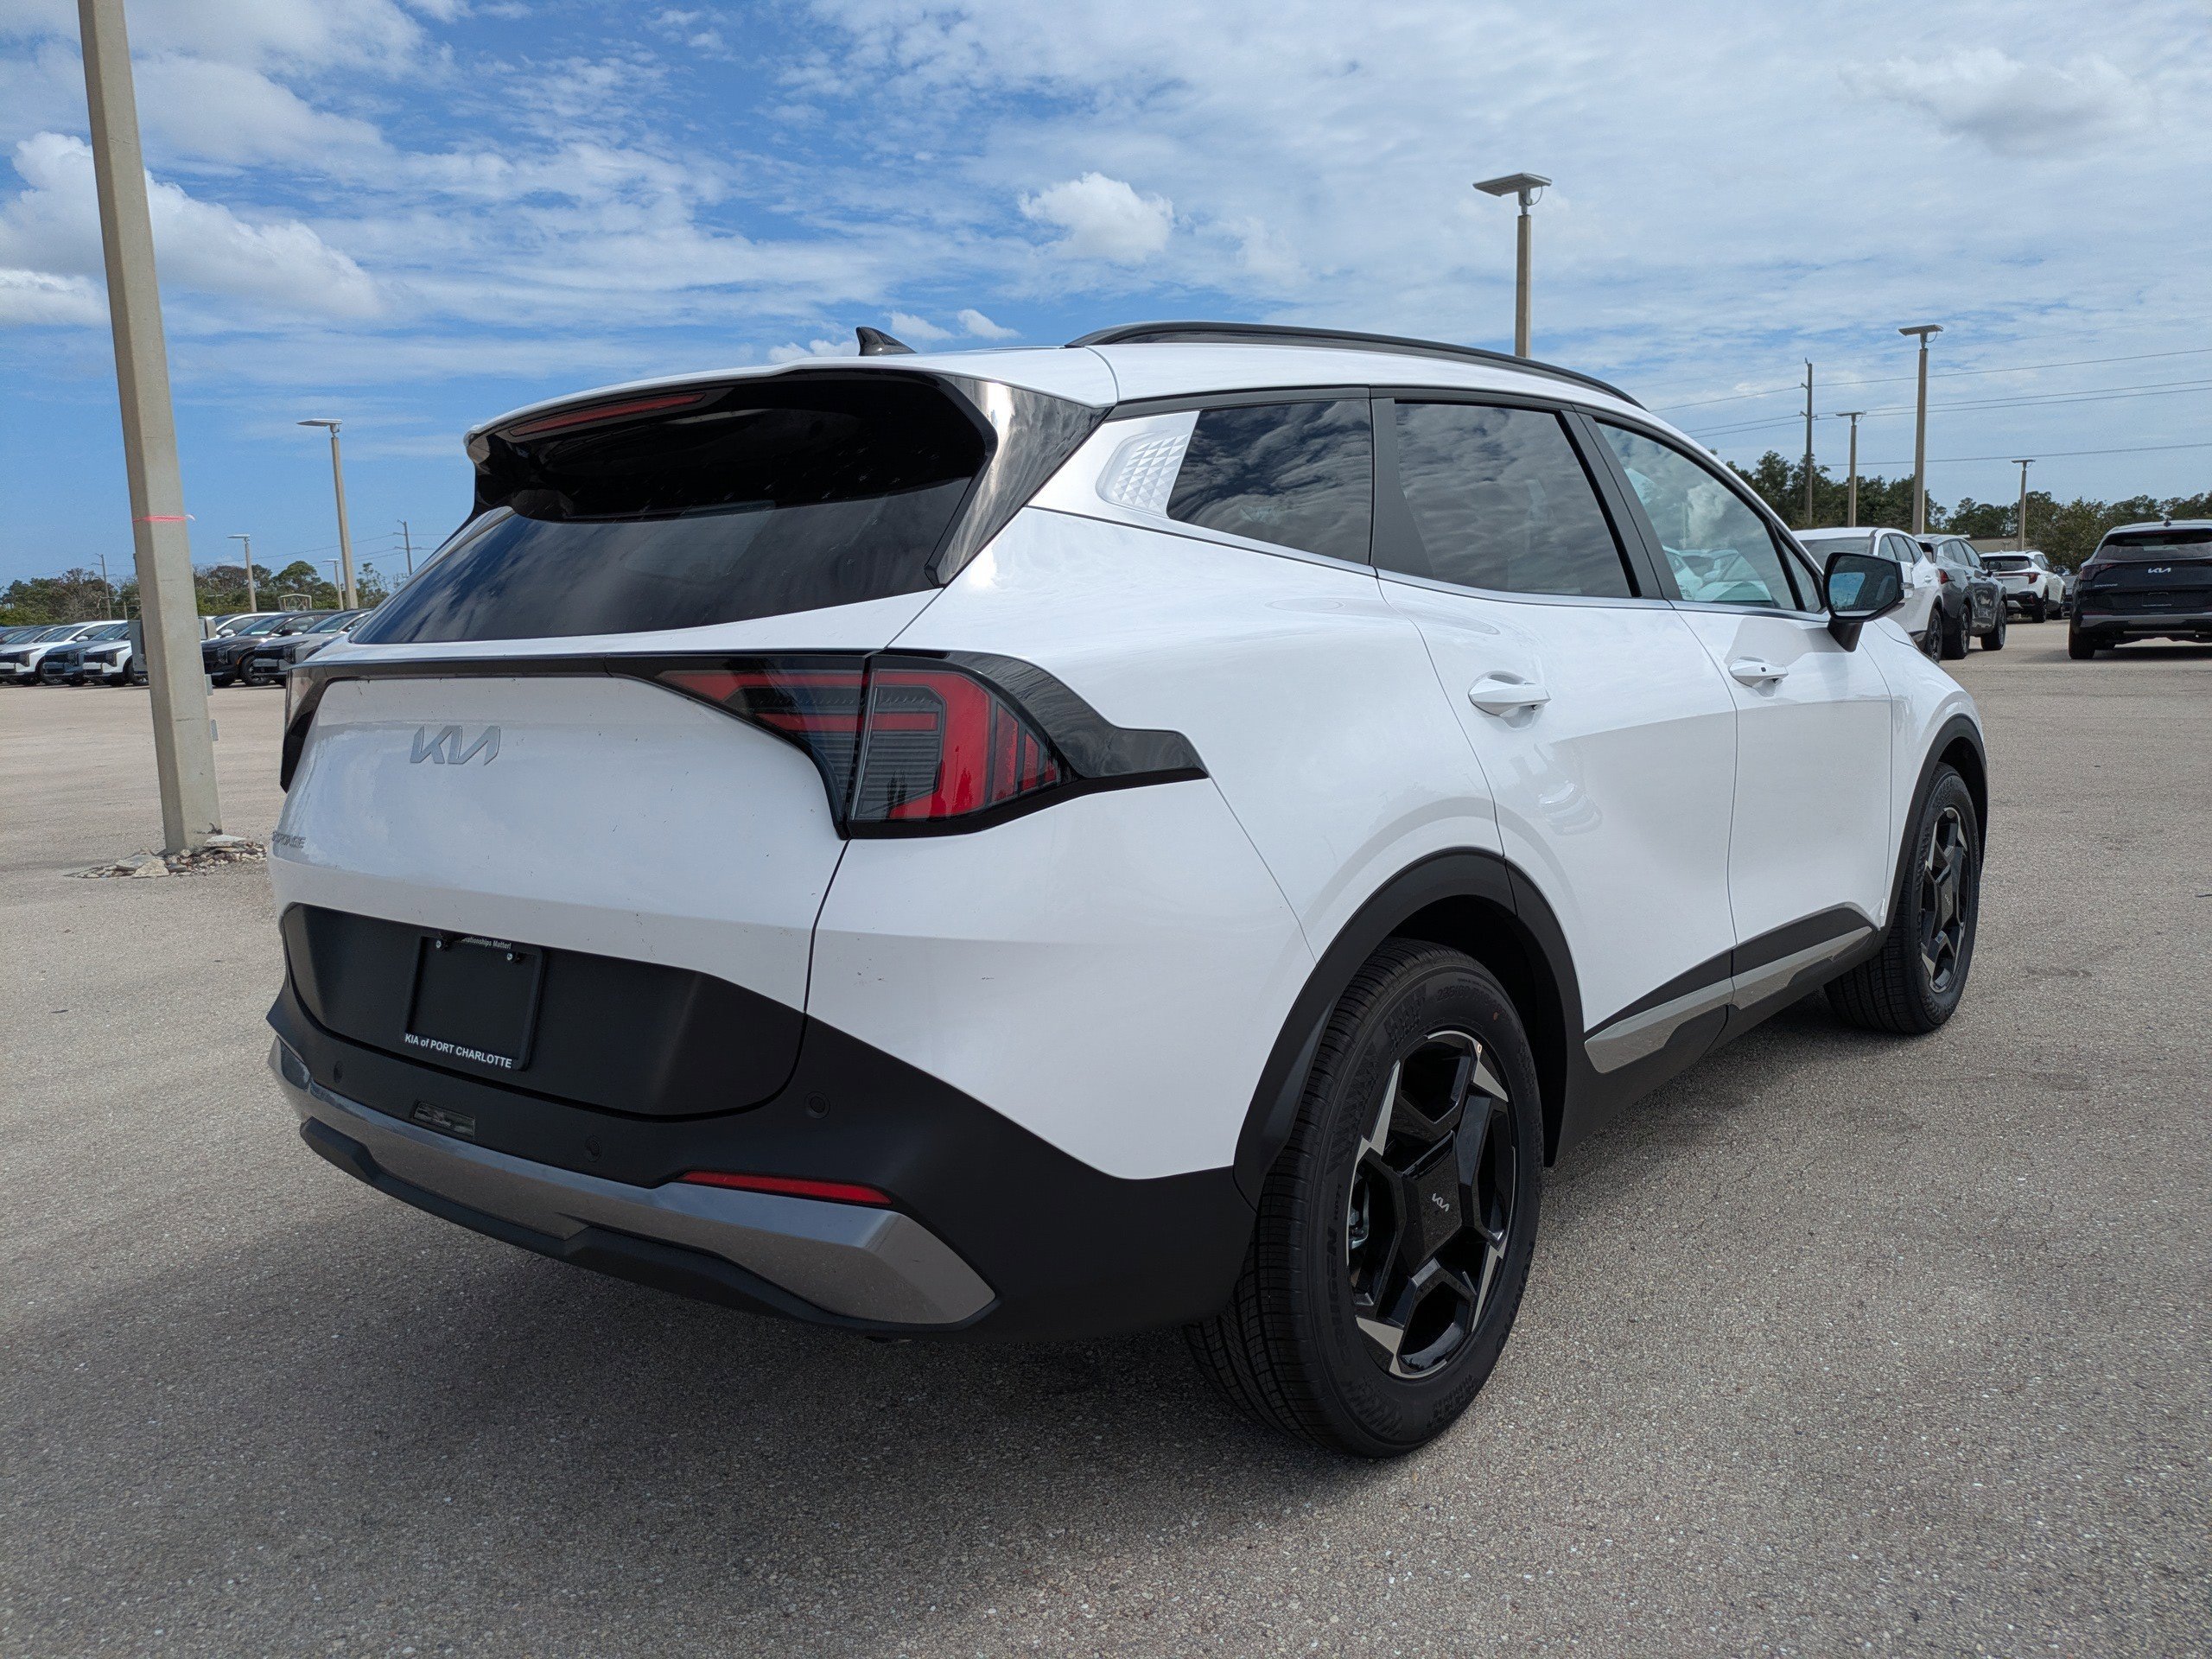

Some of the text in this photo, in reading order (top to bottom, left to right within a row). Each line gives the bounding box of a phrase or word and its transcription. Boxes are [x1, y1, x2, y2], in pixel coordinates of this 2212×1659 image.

[410, 725, 501, 766] KIA
[404, 1033, 513, 1069] KIA of PORT CHARLOTTE
